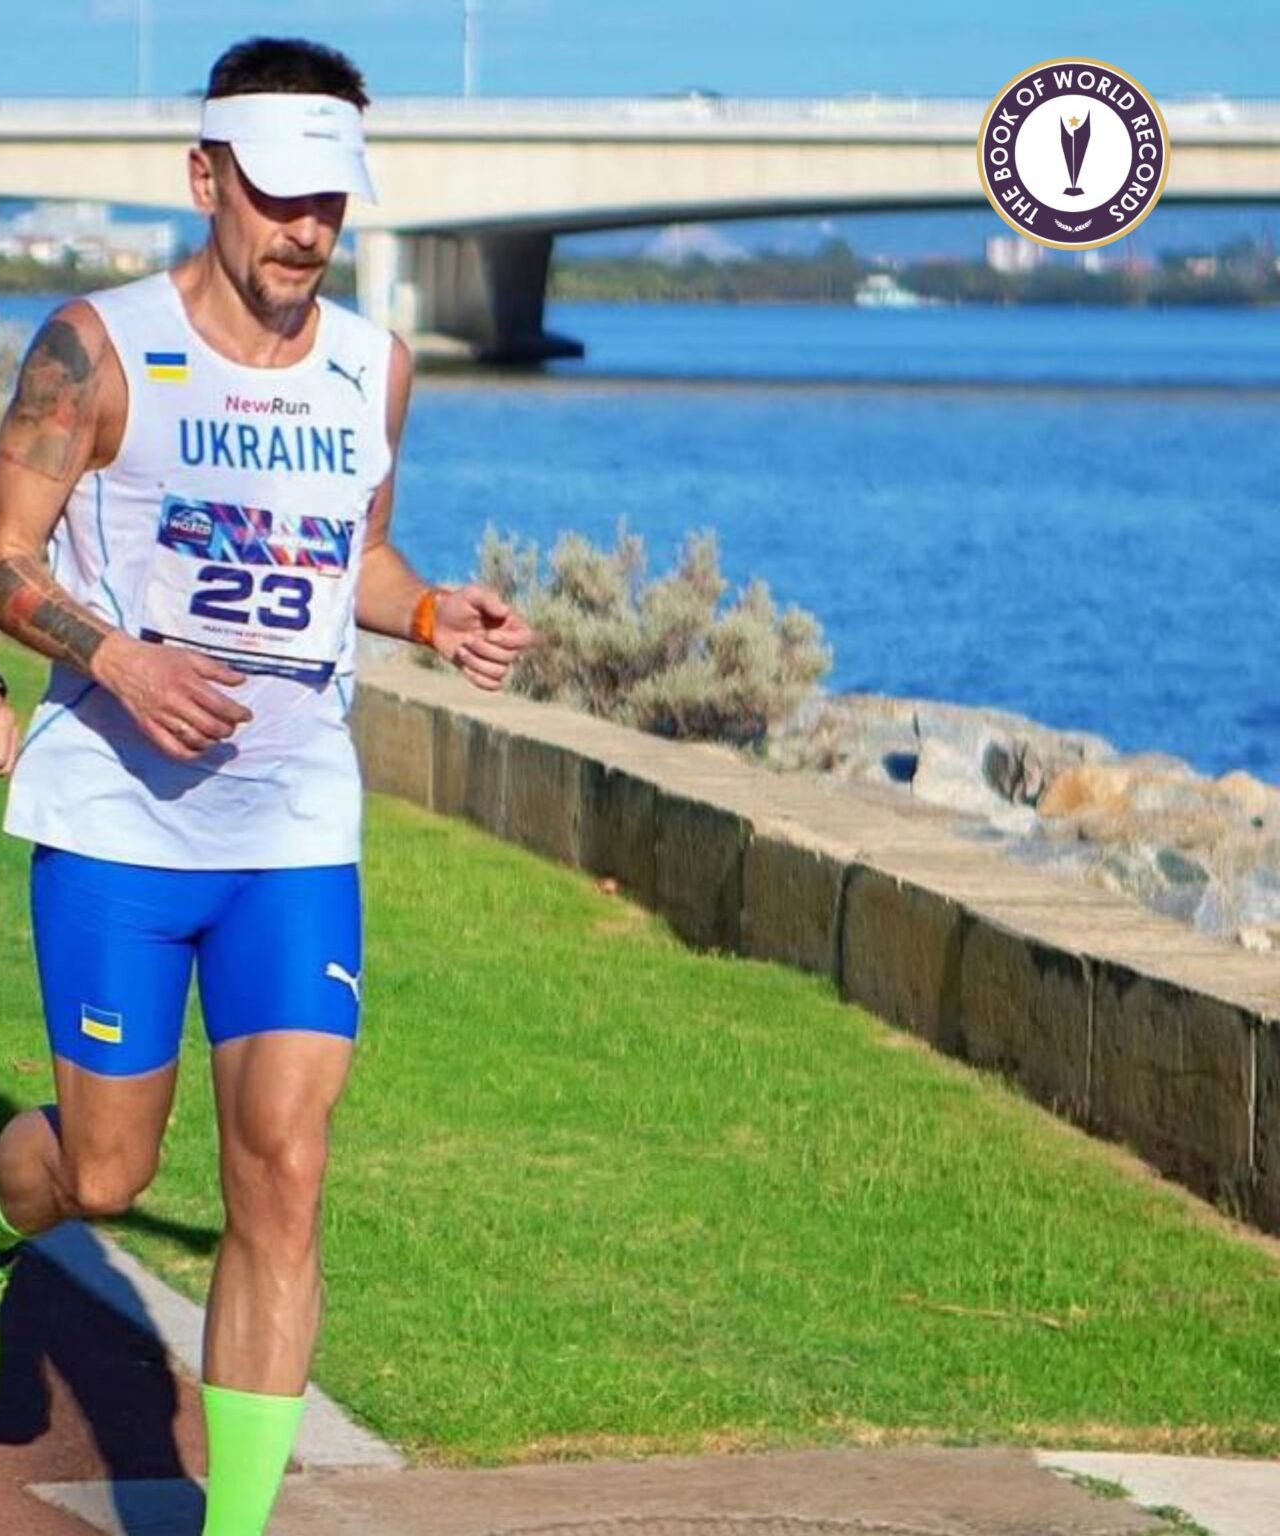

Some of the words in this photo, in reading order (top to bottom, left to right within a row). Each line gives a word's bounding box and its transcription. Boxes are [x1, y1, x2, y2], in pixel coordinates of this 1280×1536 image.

[224, 395, 311, 416] NewRun
[179, 418, 357, 476] UKRAINE
[189, 565, 314, 632] 23
